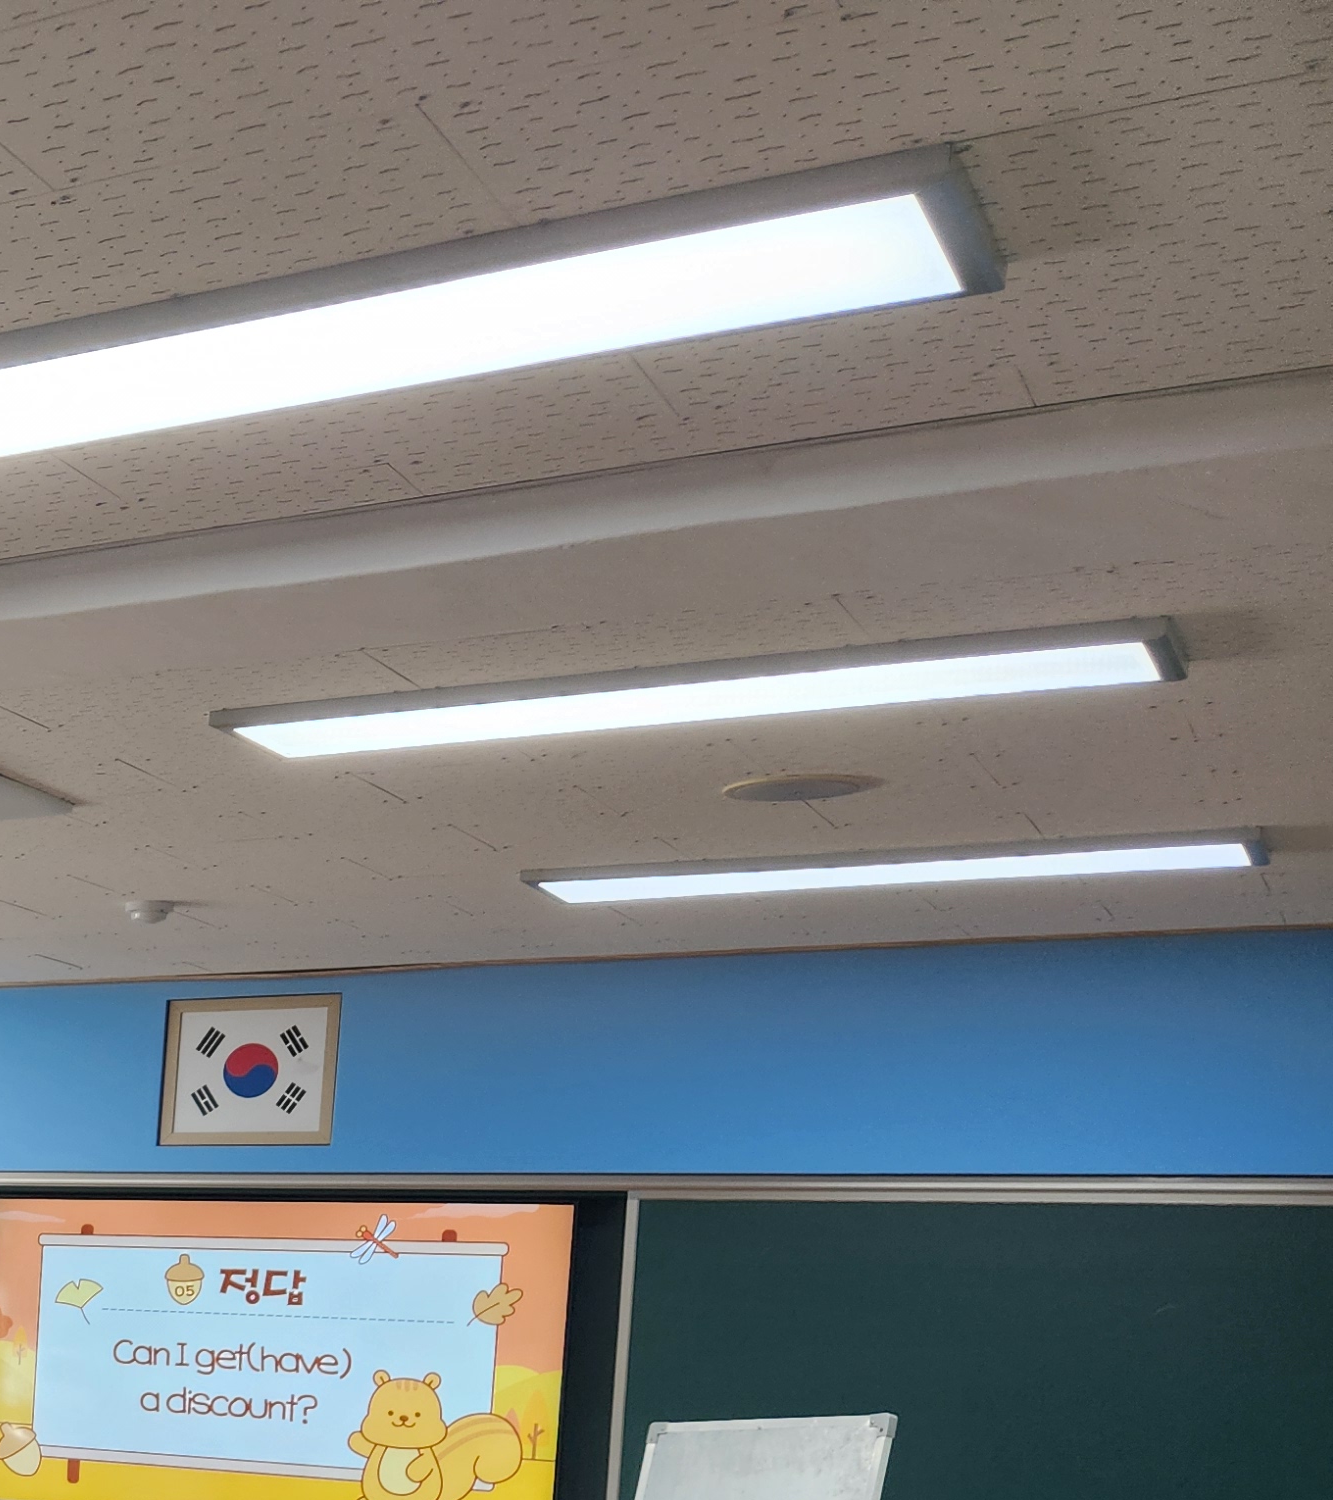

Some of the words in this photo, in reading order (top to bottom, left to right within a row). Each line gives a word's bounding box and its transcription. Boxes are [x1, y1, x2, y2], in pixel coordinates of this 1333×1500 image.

[174, 1283, 195, 1298] 05
[218, 1267, 308, 1307] 정답
[112, 1337, 171, 1367] Can
[176, 1342, 188, 1367] I
[196, 1341, 353, 1380] get(have)
[139, 1393, 160, 1413] a
[166, 1389, 319, 1424] discount?
